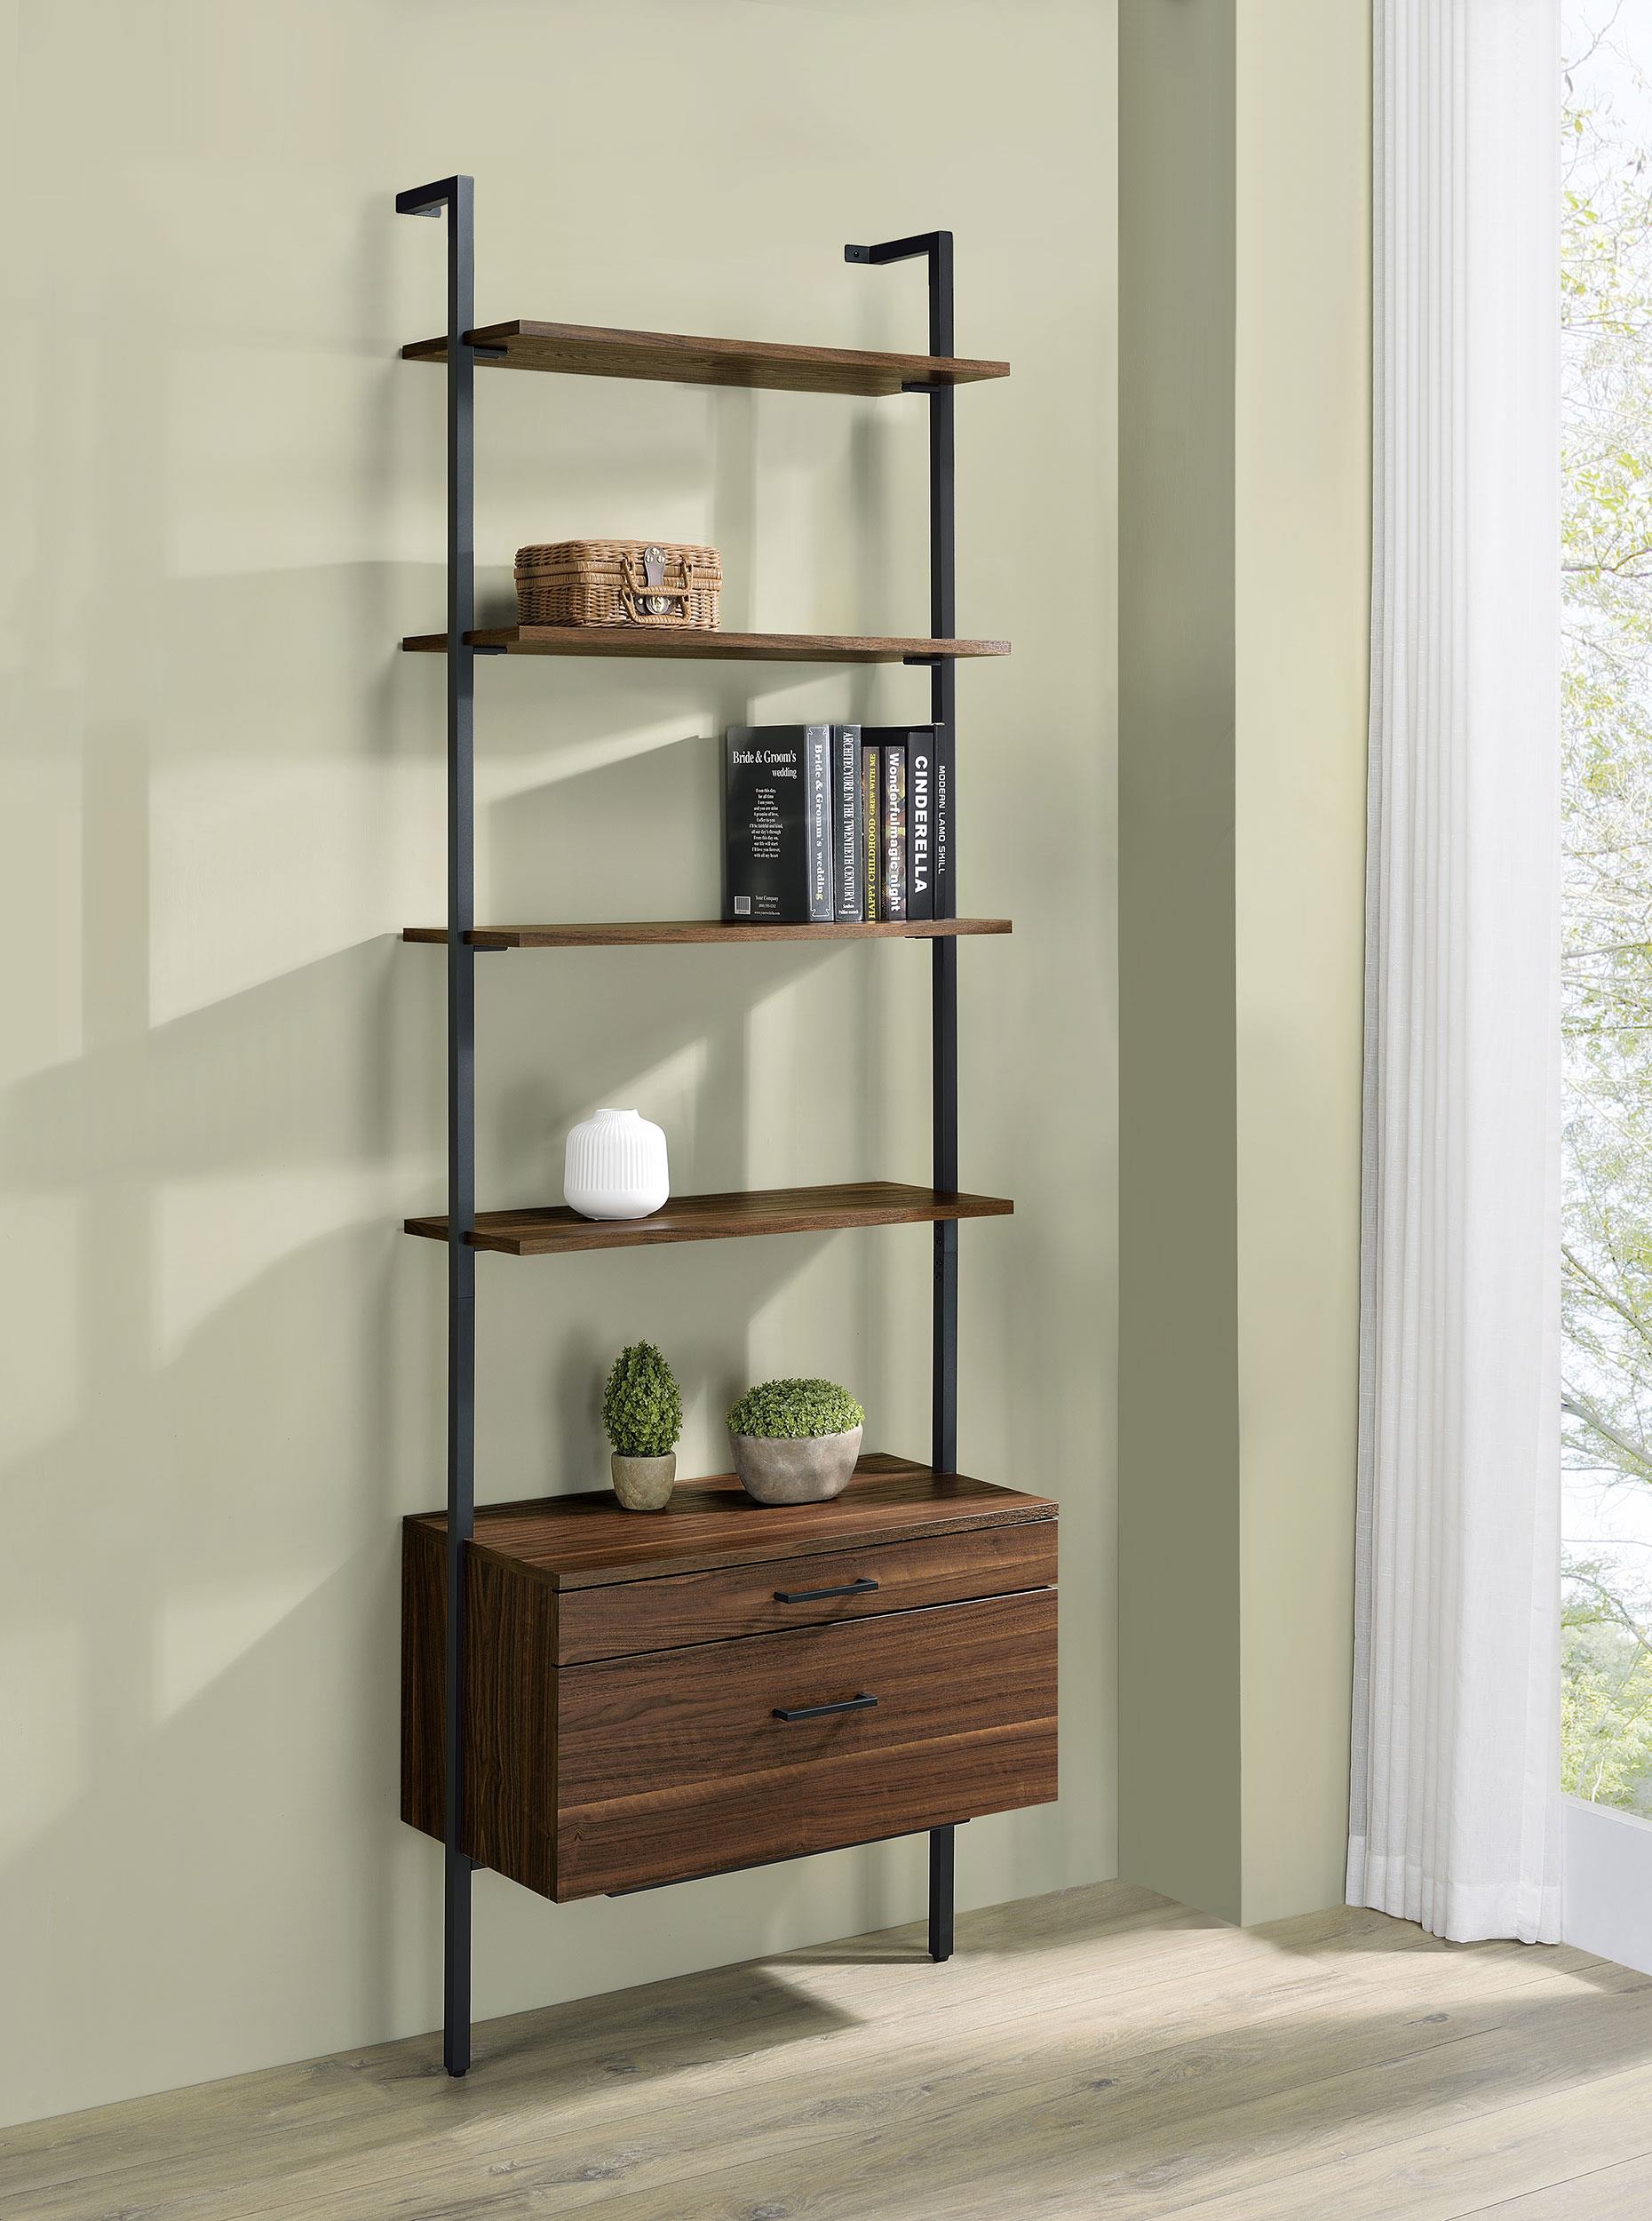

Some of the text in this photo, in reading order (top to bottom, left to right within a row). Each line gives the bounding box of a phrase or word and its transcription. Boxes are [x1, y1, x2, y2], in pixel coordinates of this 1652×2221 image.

[733, 749, 797, 764] Bride & Groom's
[814, 744, 823, 778] Bride
[870, 753, 876, 767] ME
[772, 767, 798, 780] wedding
[815, 780, 823, 792] &
[843, 792, 854, 802] IN
[843, 802, 854, 819] THE
[914, 755, 928, 894] CINDERELLA
[844, 820, 854, 865] TWENTIETH
[844, 865, 855, 903] CENTURY
[888, 874, 901, 911] night
